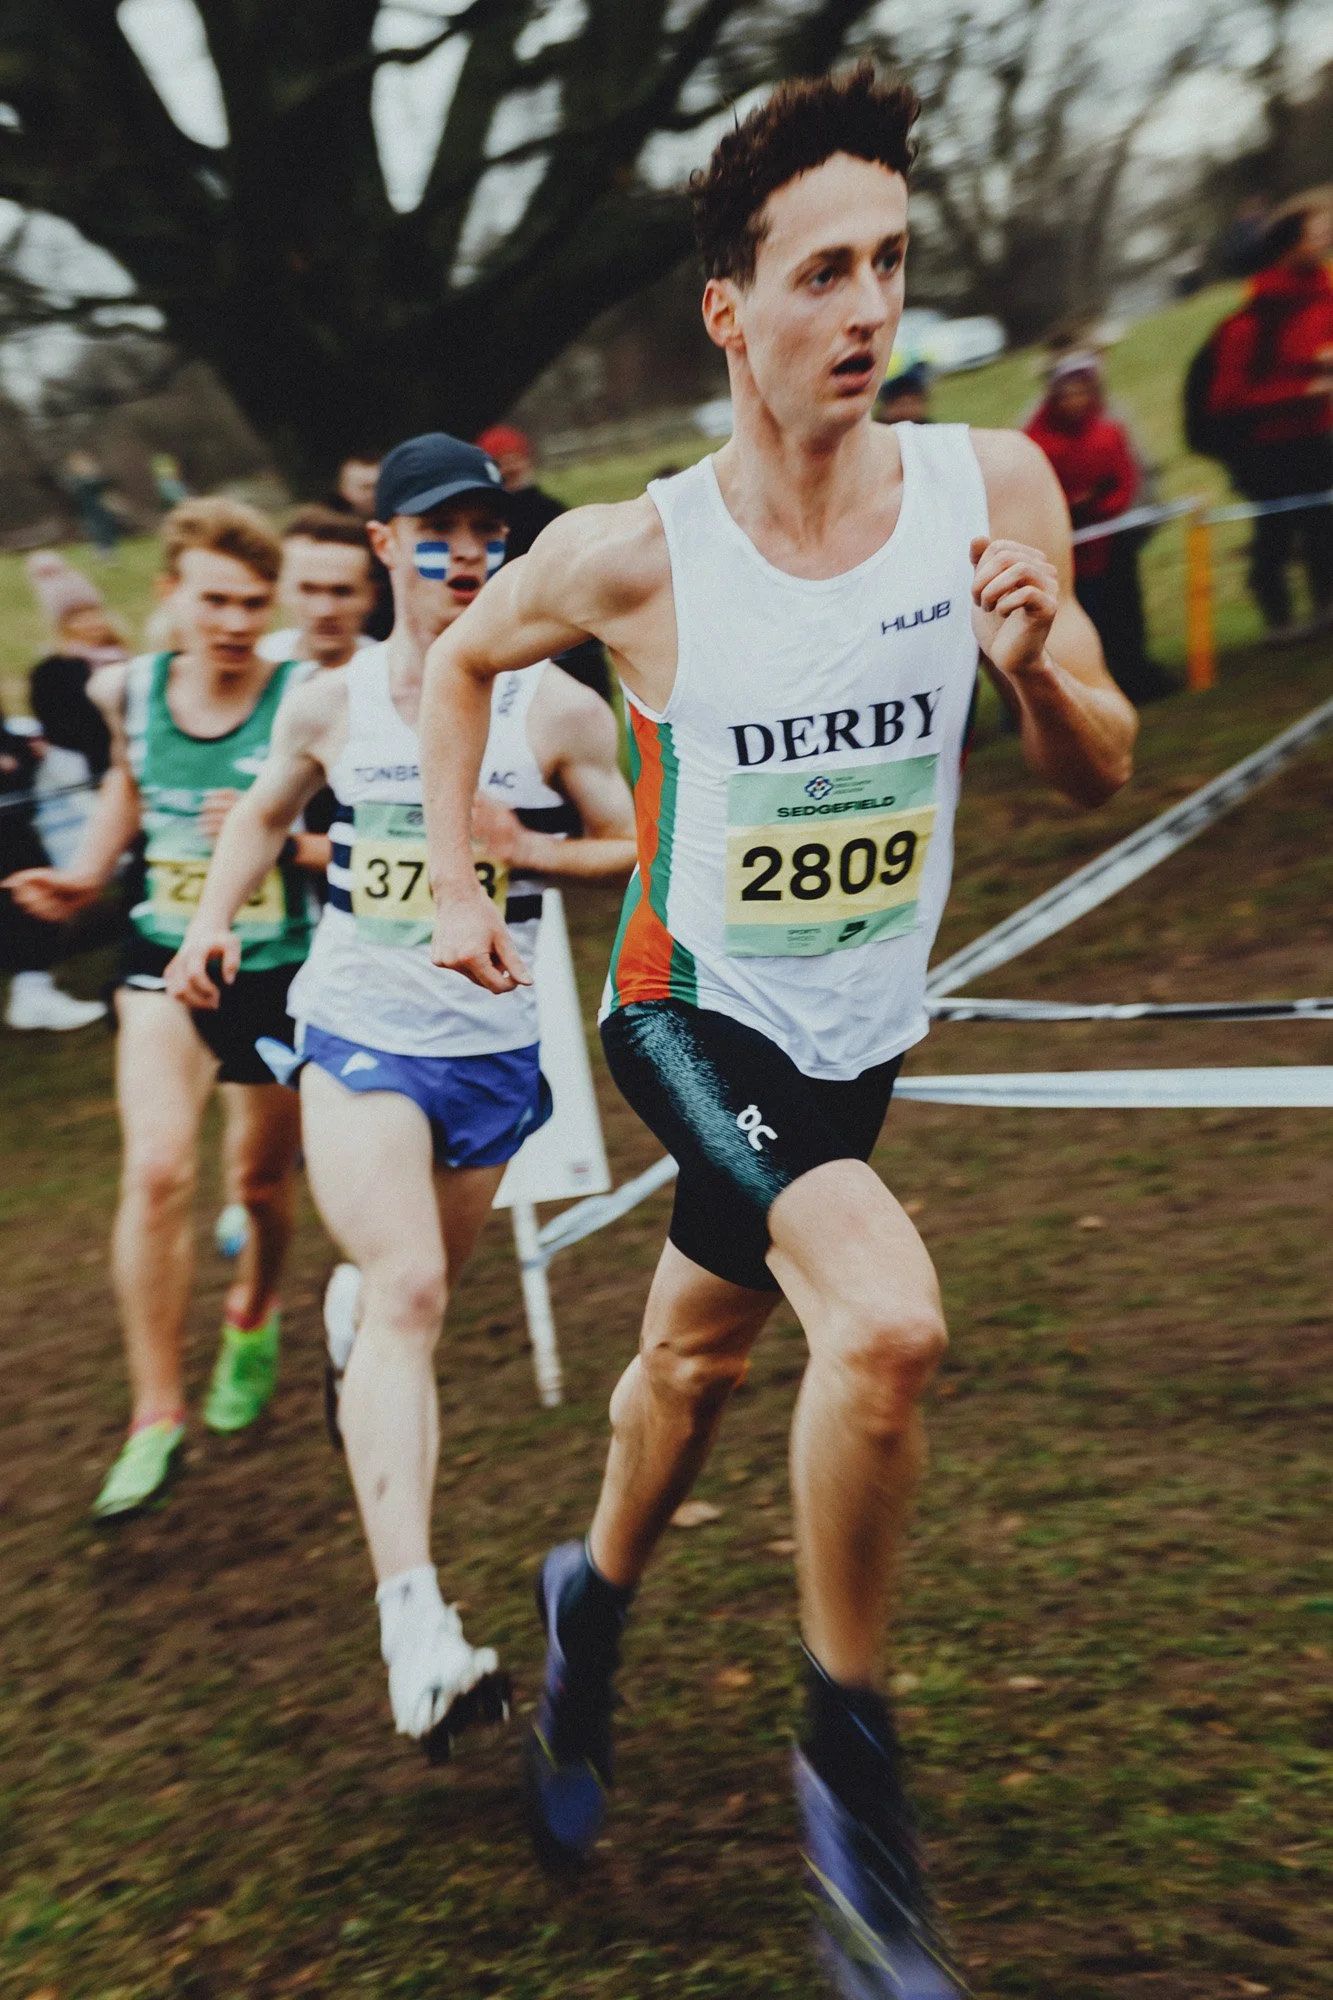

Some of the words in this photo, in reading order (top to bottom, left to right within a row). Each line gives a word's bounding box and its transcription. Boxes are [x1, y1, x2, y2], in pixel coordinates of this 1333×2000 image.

[881, 600, 951, 636] HUUB
[728, 685, 945, 766] DERBY
[488, 770, 516, 789] AC
[777, 795, 896, 818] SEDGEFIELD
[741, 830, 917, 901] 2809
